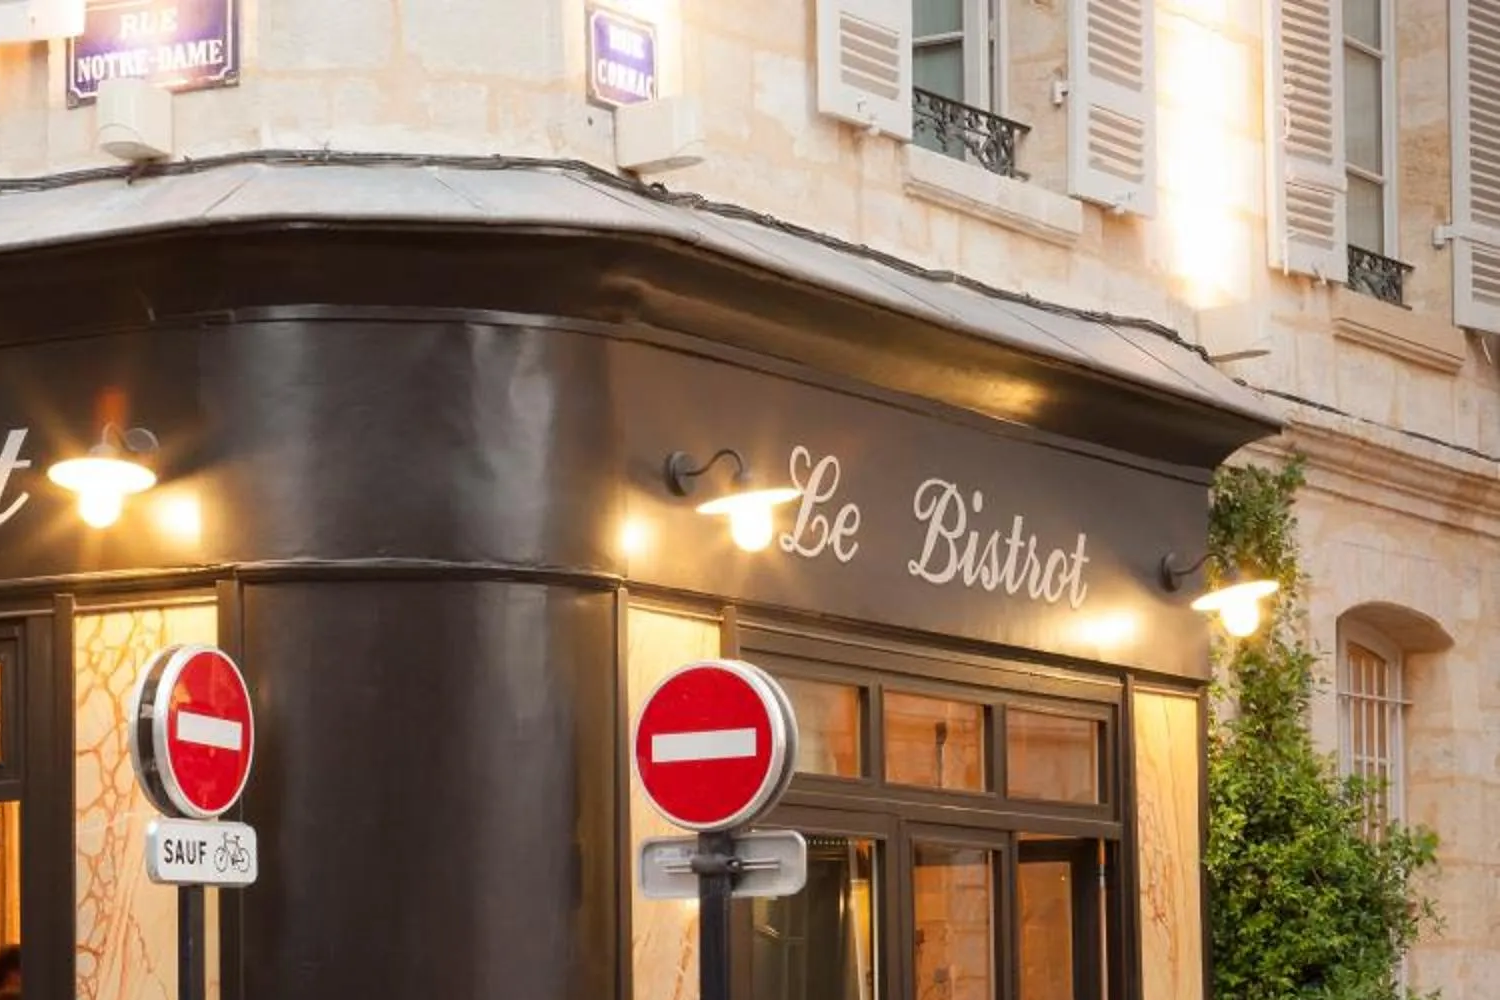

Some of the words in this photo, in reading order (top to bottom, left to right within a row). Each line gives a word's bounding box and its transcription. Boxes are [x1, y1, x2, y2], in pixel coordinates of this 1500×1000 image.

[119, 8, 178, 38] RUE
[77, 40, 224, 82] NOTRE-DAME
[780, 445, 861, 562] Le
[908, 477, 1090, 609] Bistrot
[164, 838, 207, 864] SAUF
